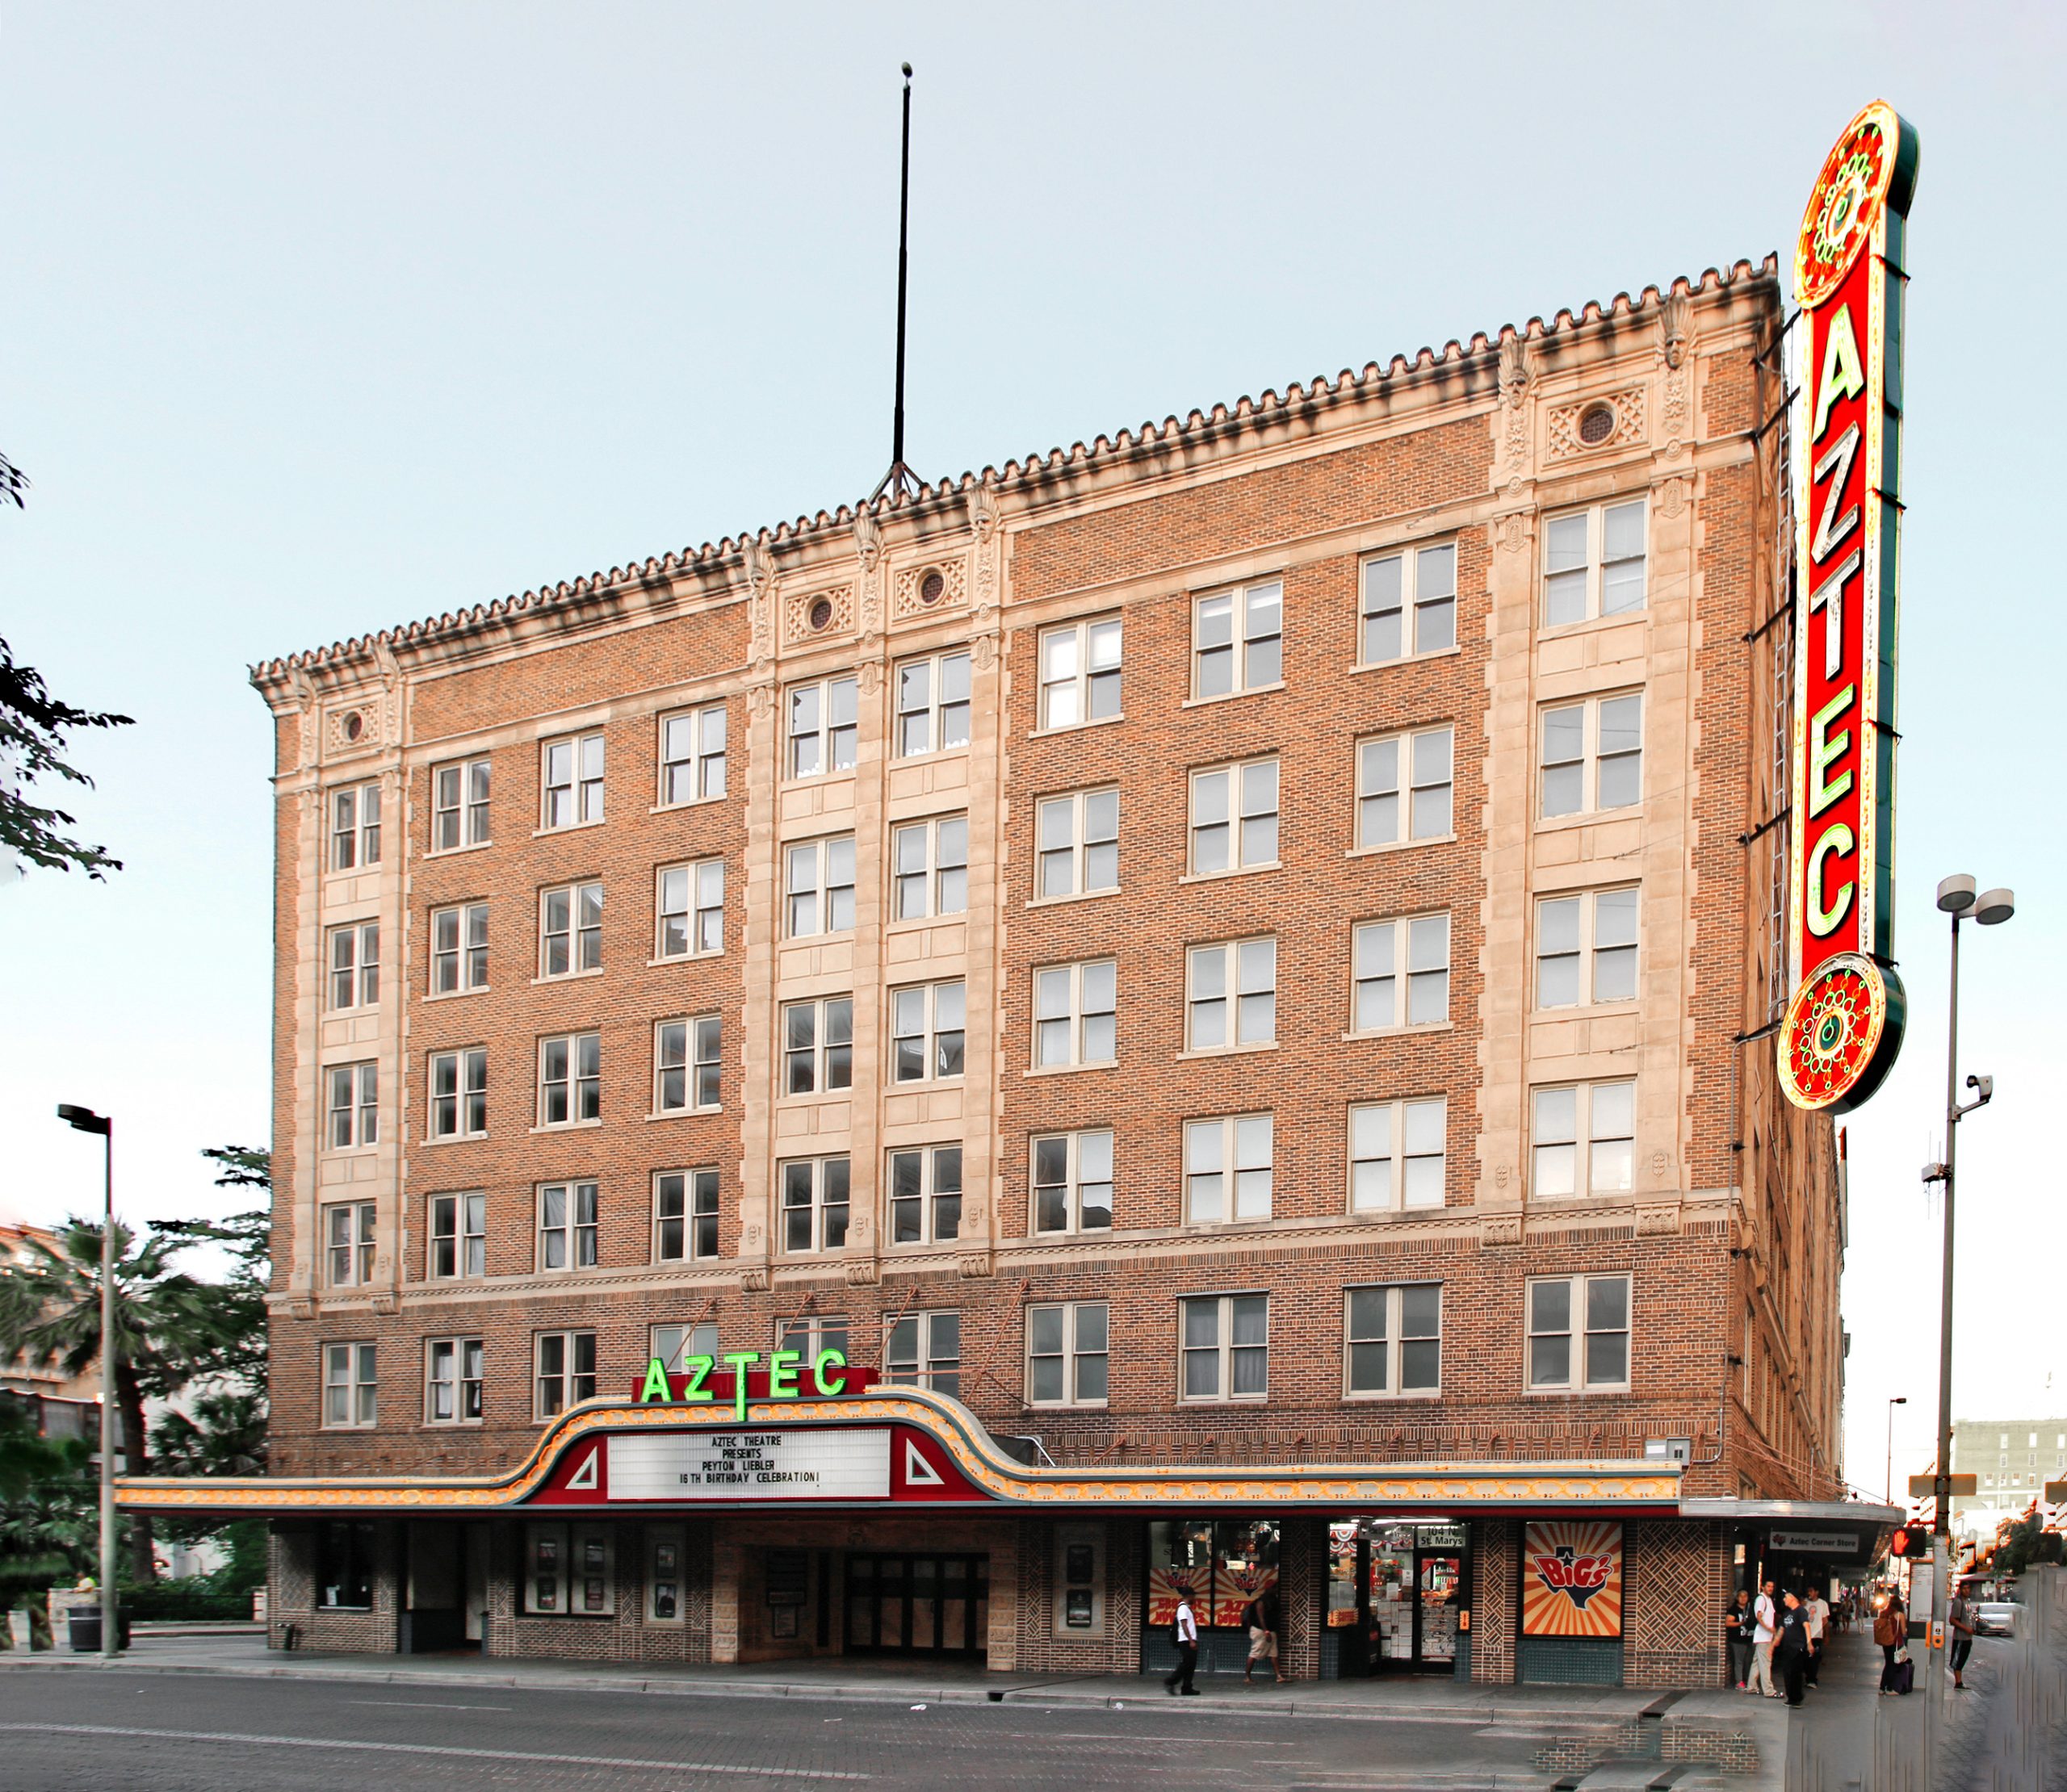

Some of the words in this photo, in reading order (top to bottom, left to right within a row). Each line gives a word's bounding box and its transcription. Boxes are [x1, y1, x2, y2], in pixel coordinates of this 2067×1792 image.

[1806, 302, 1864, 937] AZTEC
[640, 1348, 846, 1422] AZTEC
[711, 1437, 736, 1447] AZTEC
[744, 1436, 782, 1446] THEATRE
[723, 1448, 761, 1459] PRESENTS
[702, 1461, 734, 1471] PEYTON
[743, 1460, 774, 1471] LIEBLER
[706, 1473, 749, 1483] BIRTHDAY
[1428, 1526, 1444, 1535] 104
[1435, 1537, 1463, 1547] Marys
[1789, 1537, 1809, 1546] Aztec
[1811, 1538, 1834, 1546] Corner
[1837, 1539, 1855, 1547] Store
